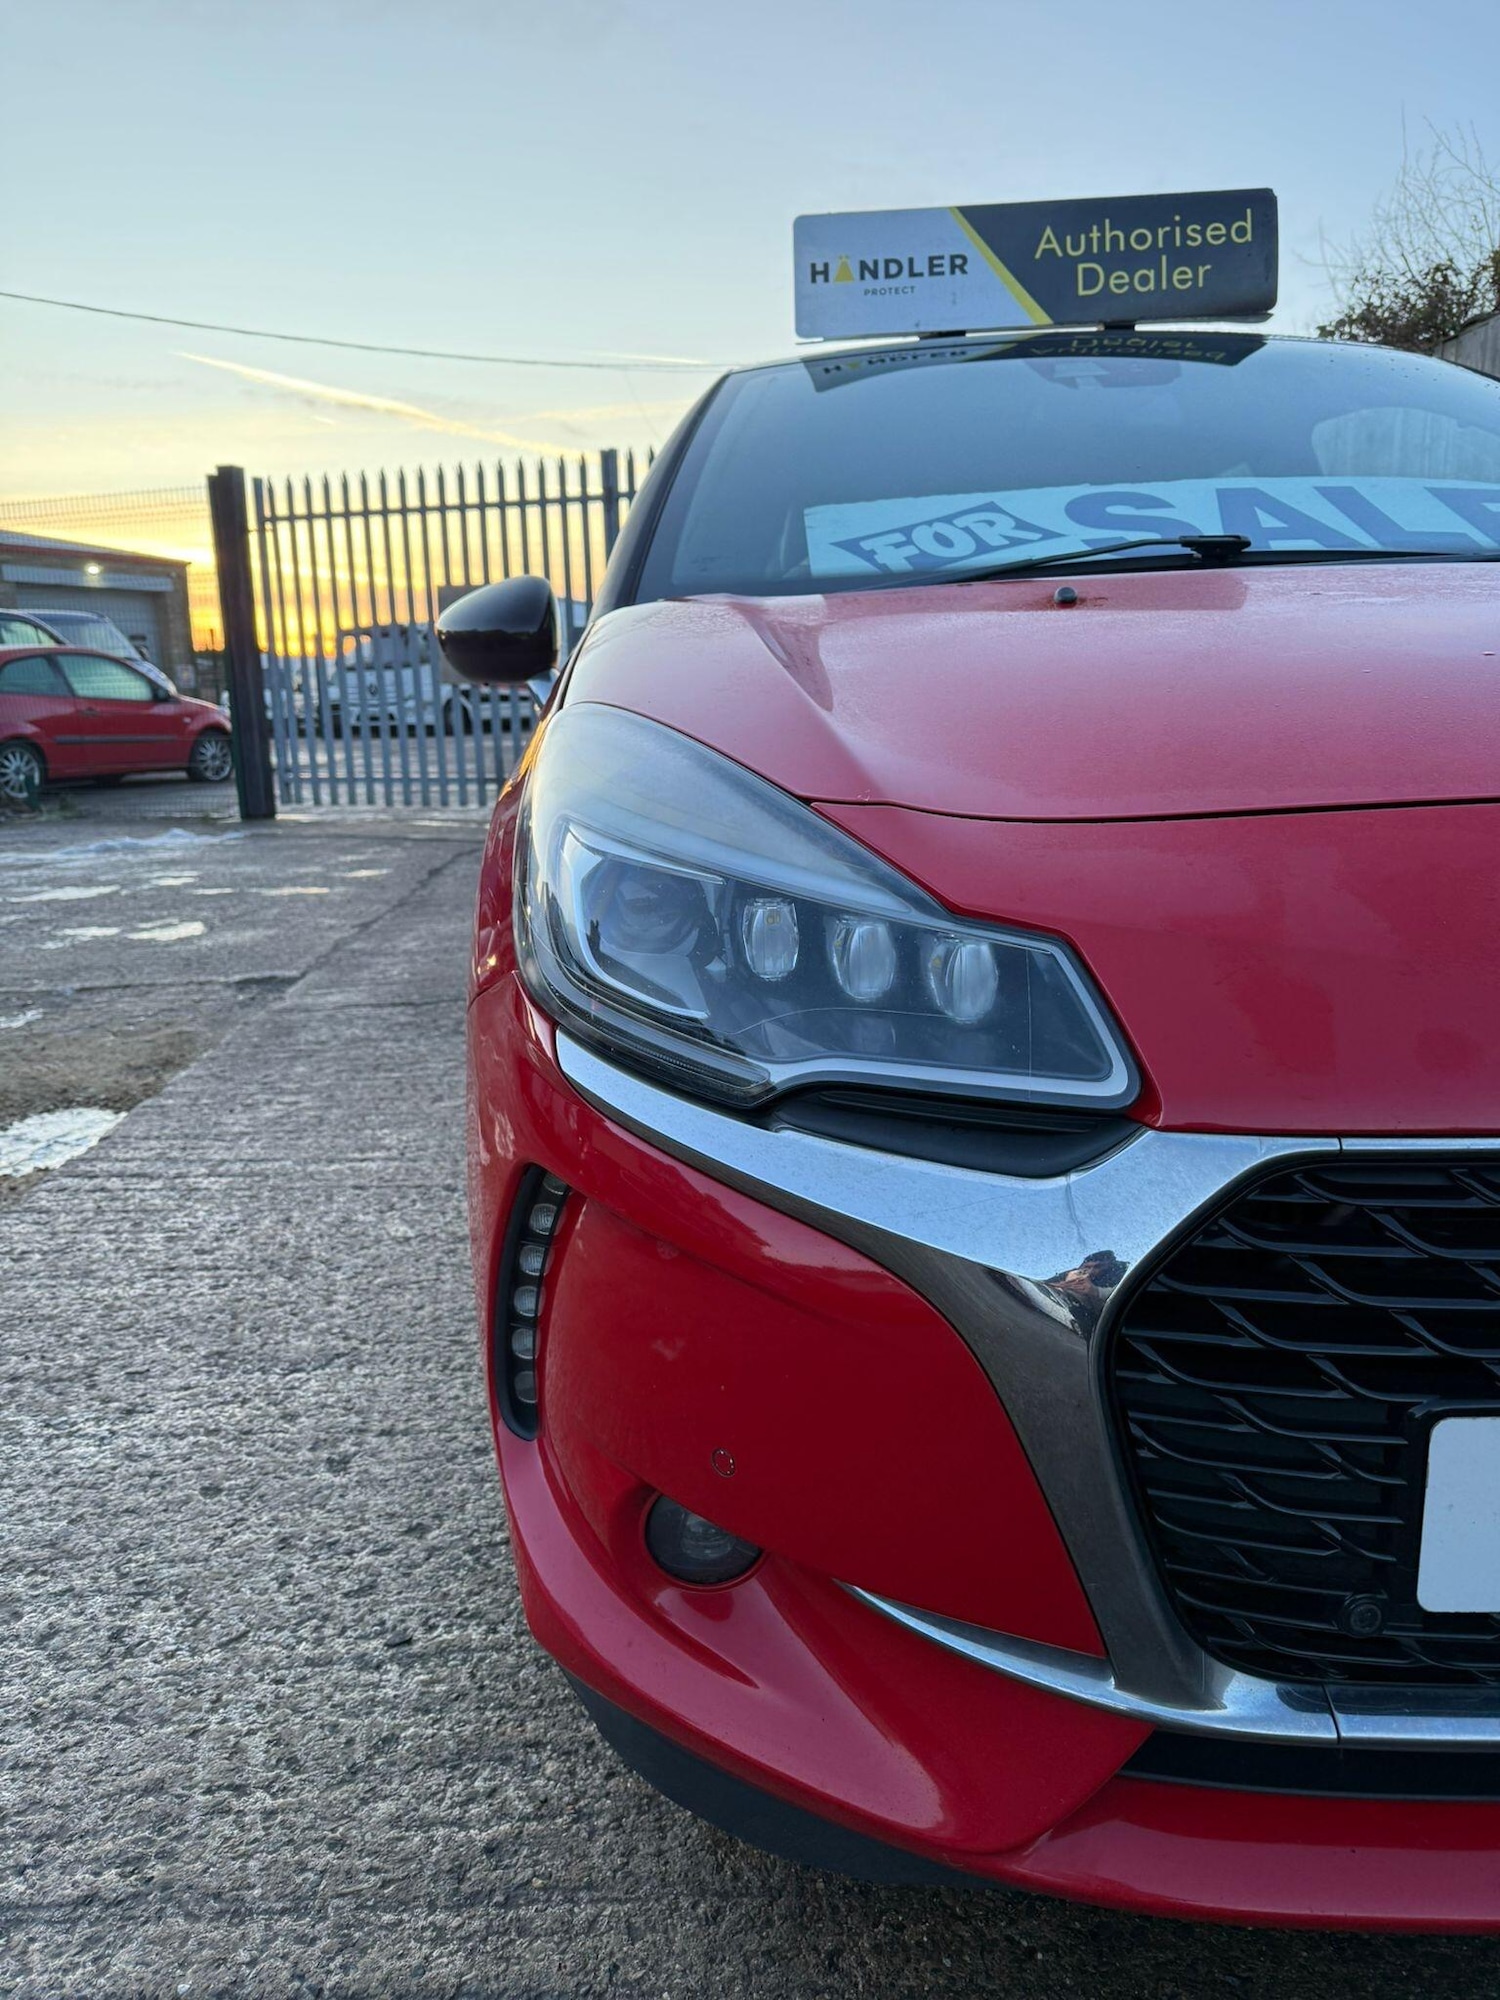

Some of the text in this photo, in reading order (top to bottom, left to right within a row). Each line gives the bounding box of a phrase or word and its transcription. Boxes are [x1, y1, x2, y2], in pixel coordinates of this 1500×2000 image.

[1034, 208, 1253, 260] Authorised
[863, 285, 916, 296] PROTECT
[1076, 254, 1212, 297] Dealer
[859, 511, 1043, 574] FOR
